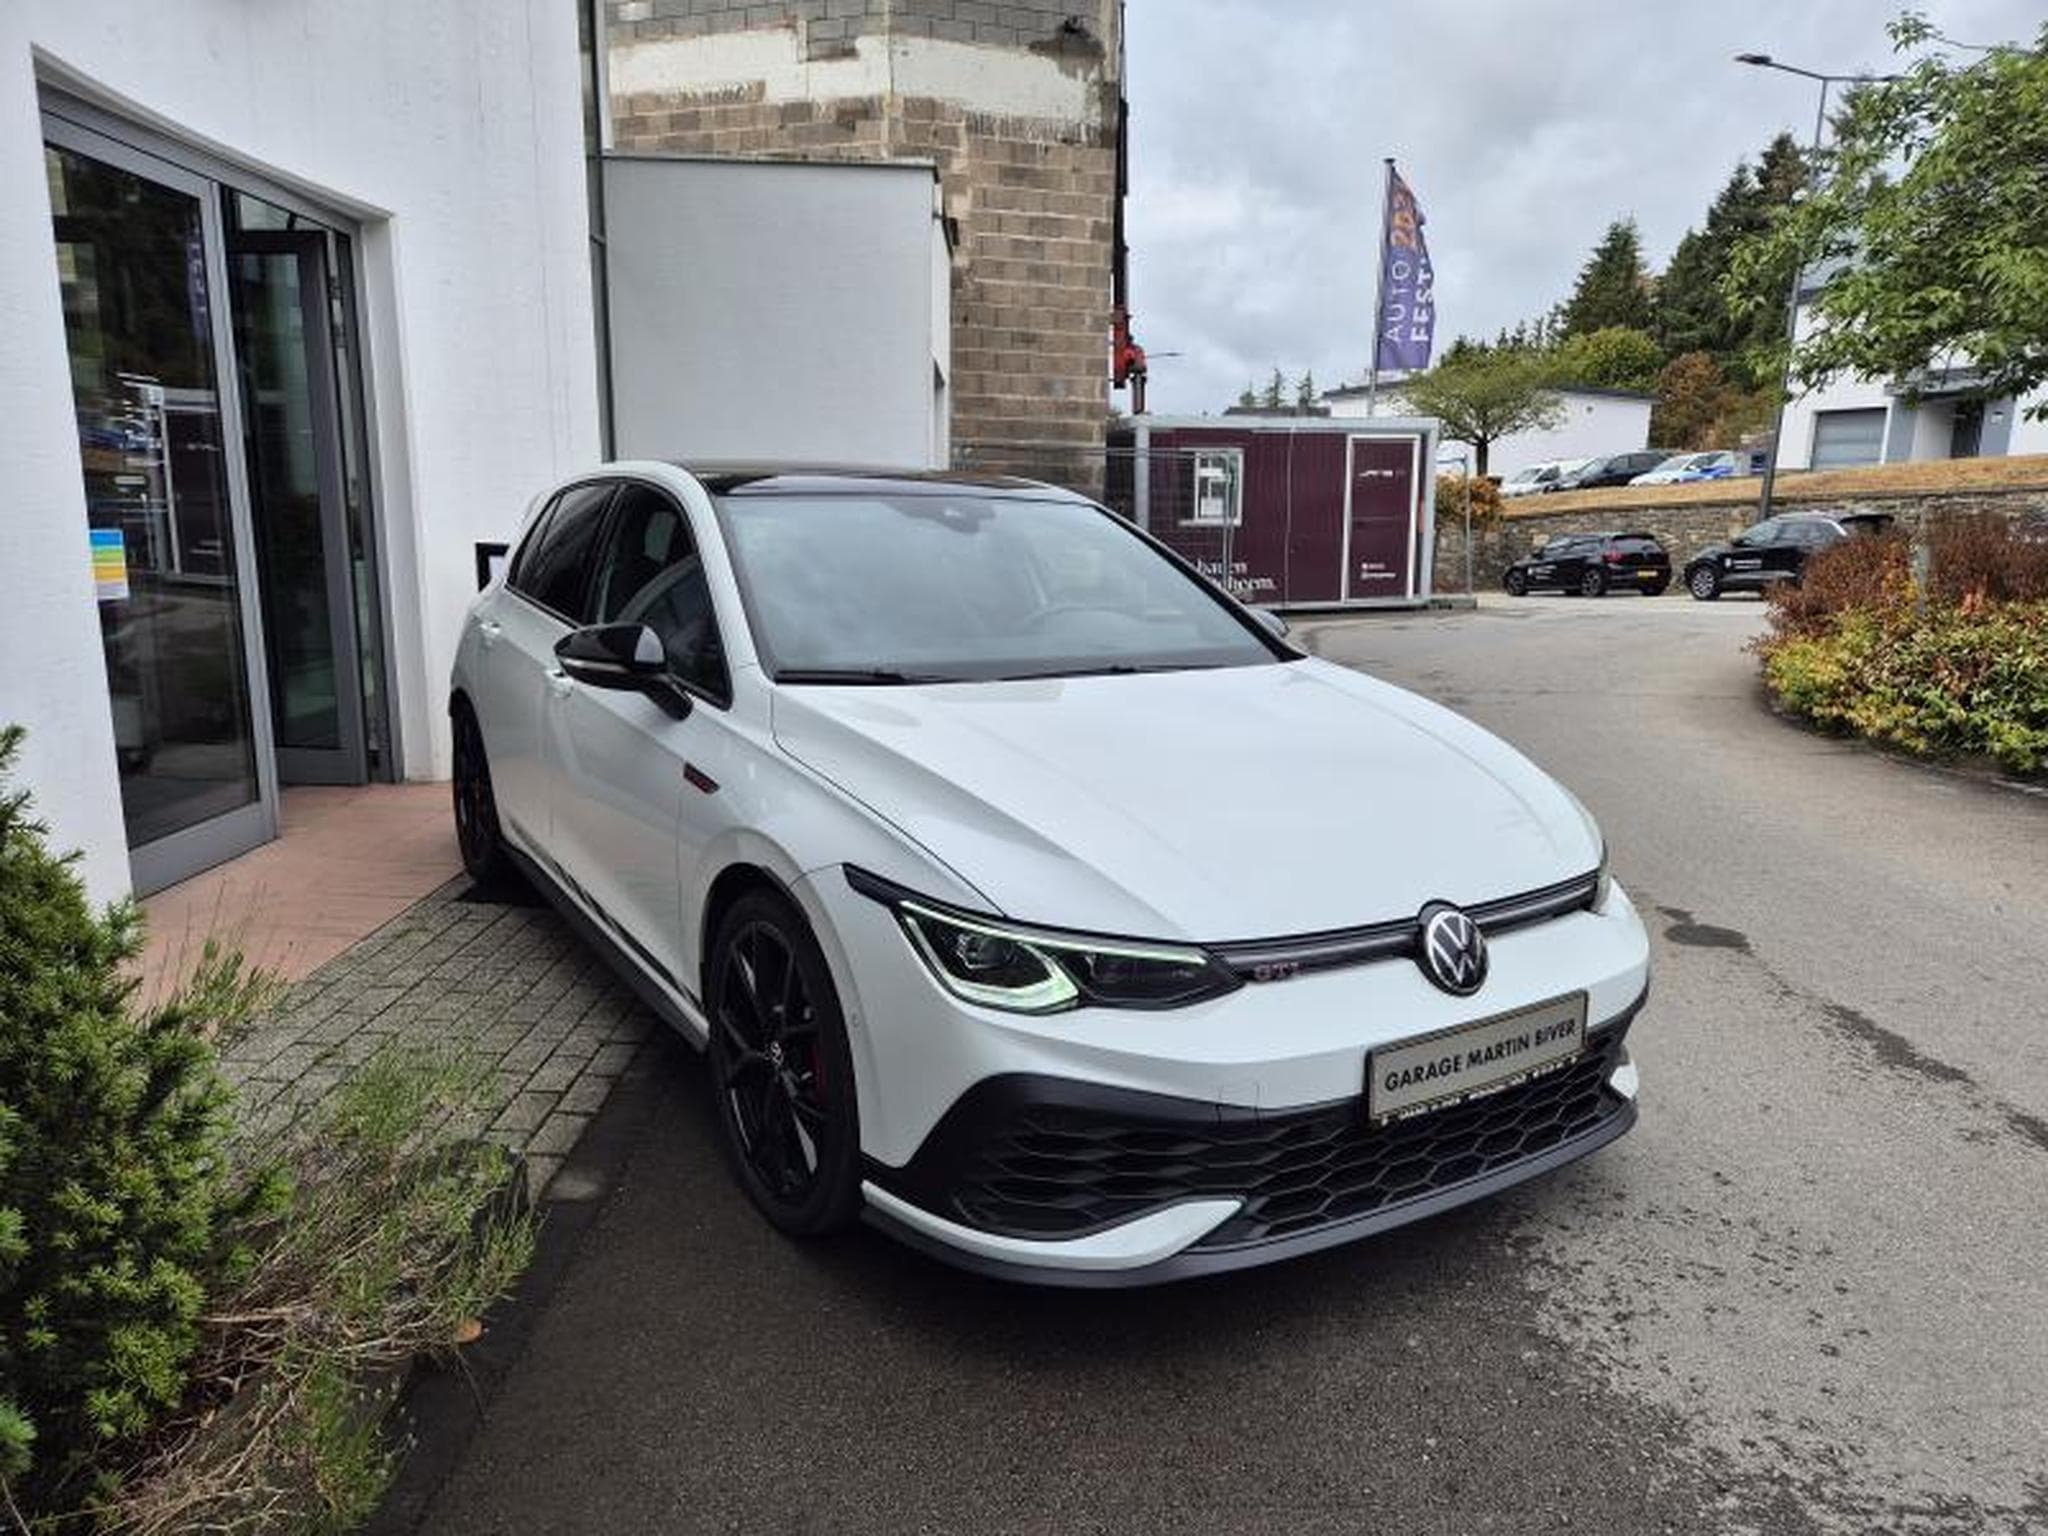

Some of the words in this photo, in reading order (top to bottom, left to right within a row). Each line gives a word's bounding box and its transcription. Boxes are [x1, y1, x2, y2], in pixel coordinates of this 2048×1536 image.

[1384, 260, 1411, 343] AUTO
[1384, 1056, 1463, 1092] GARAGE
[1466, 1033, 1530, 1070] MARTIN
[1534, 1018, 1578, 1048] BIVER
